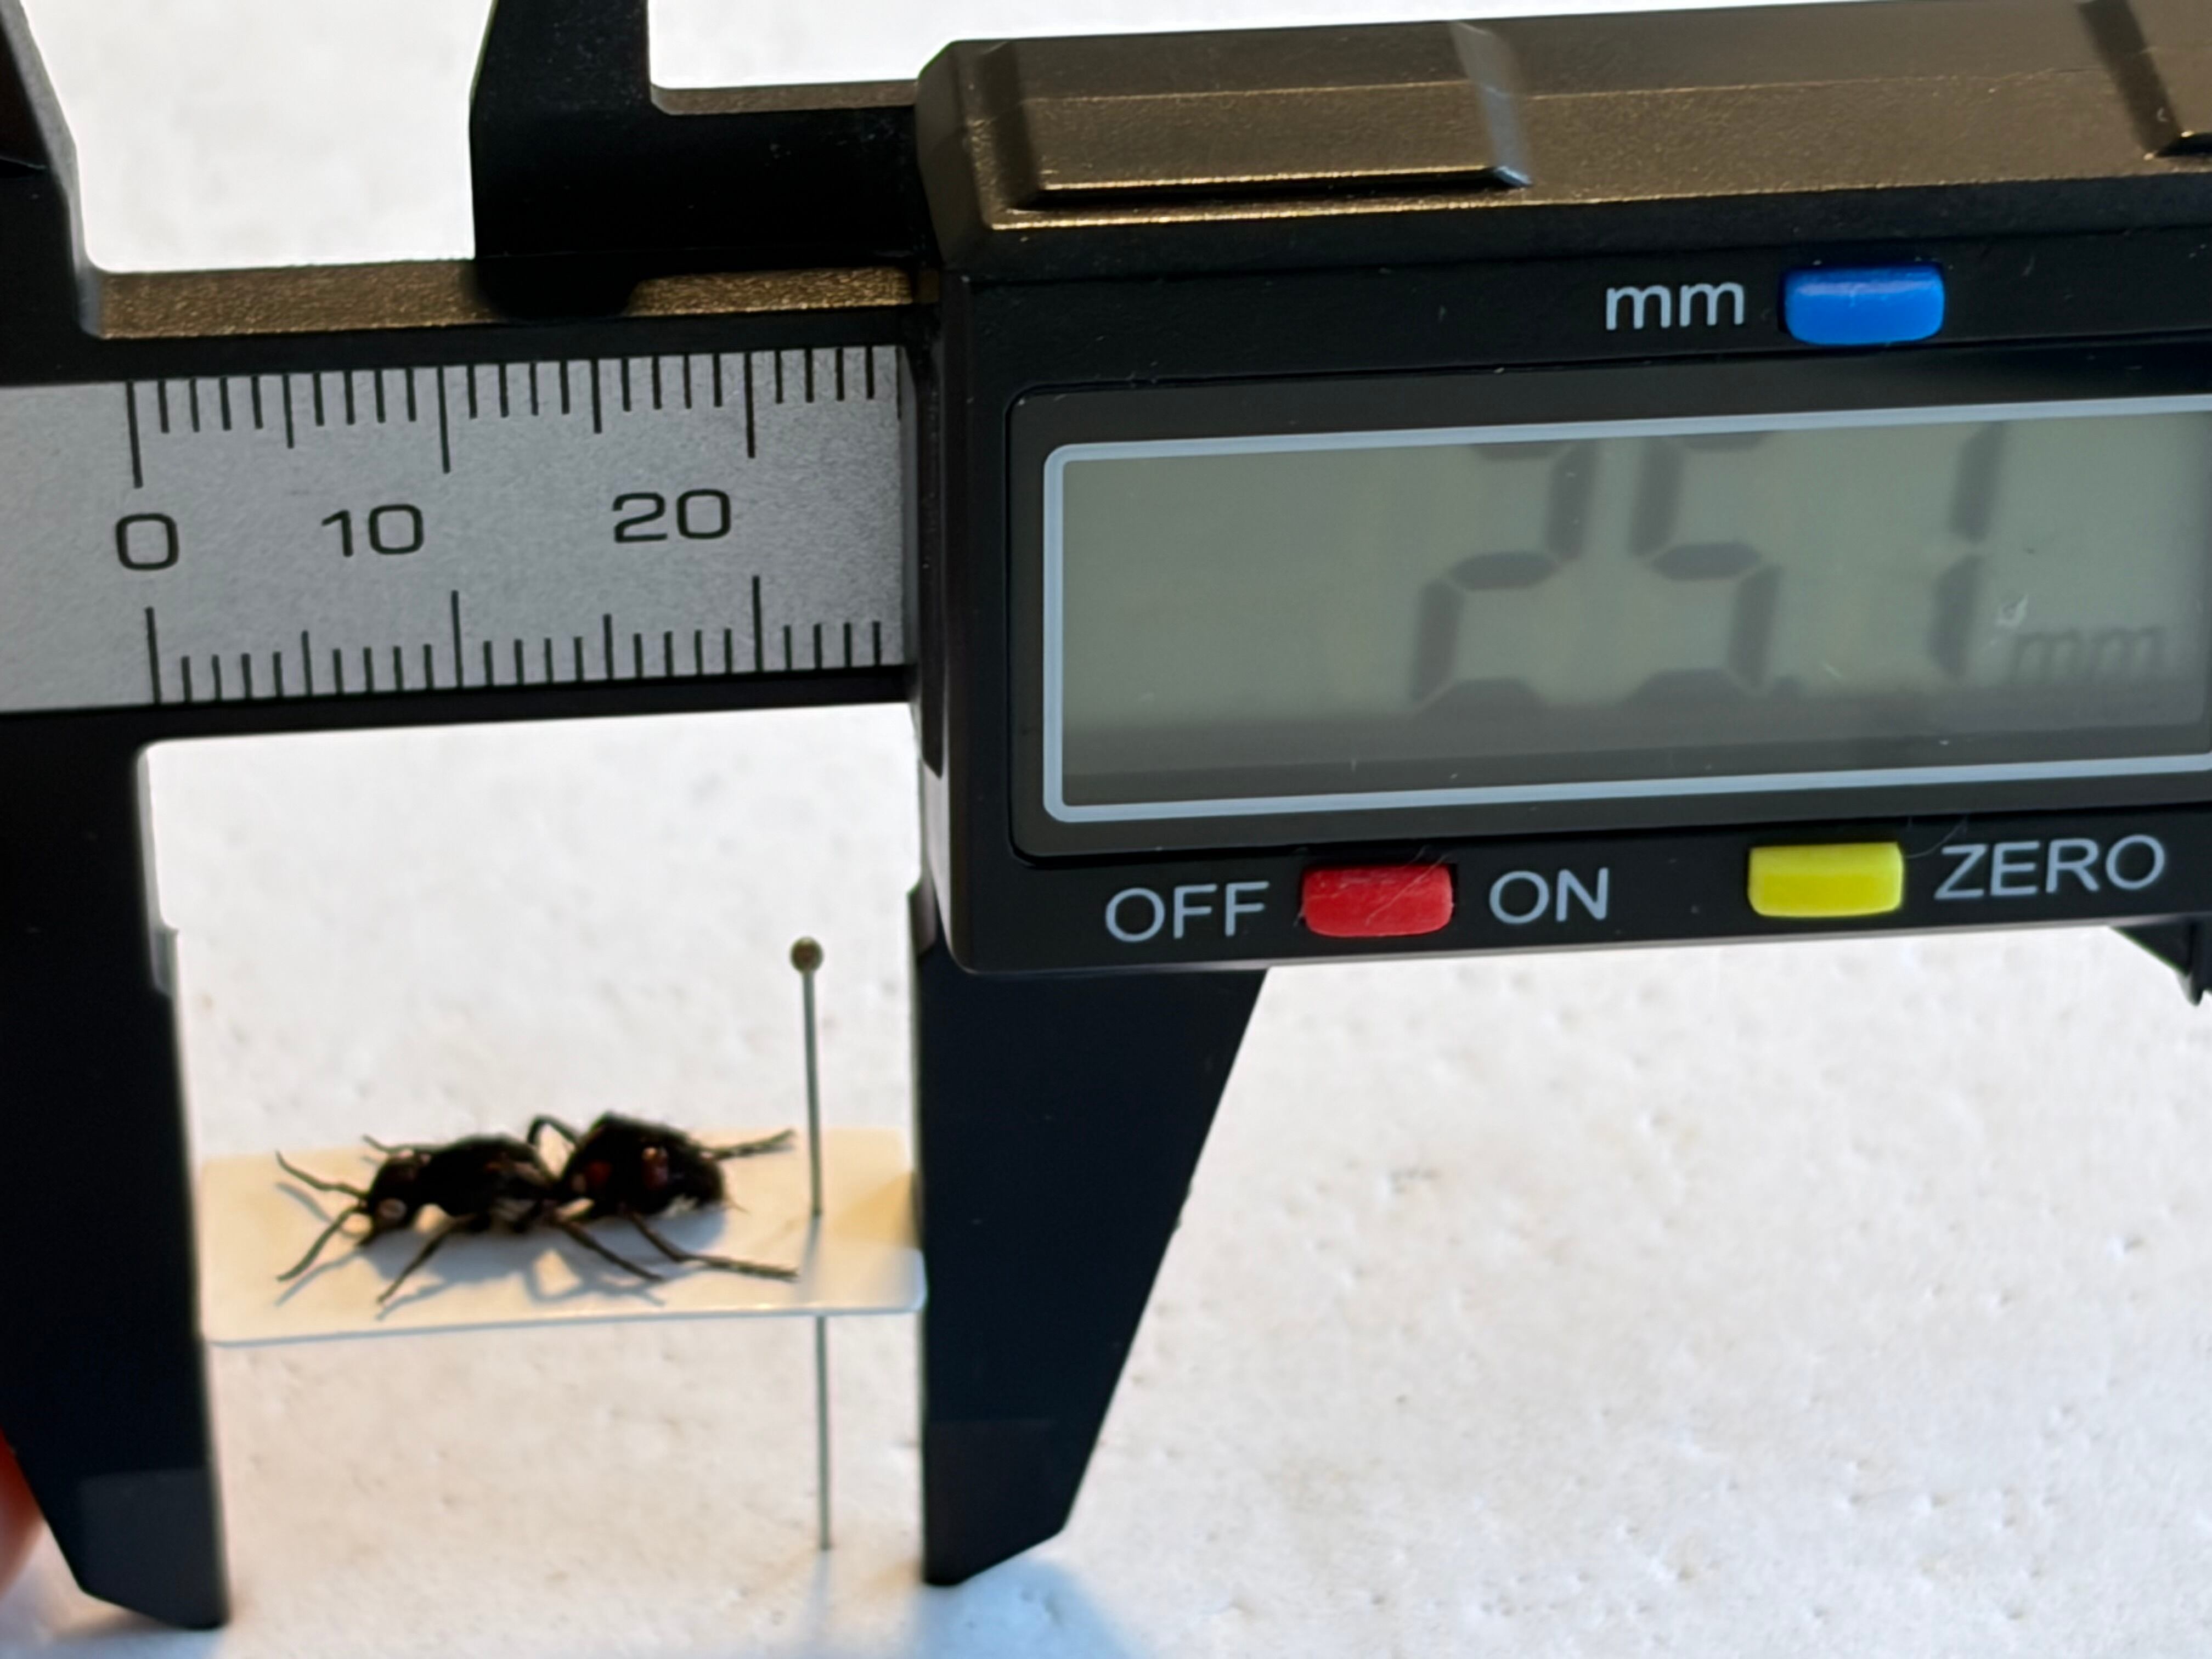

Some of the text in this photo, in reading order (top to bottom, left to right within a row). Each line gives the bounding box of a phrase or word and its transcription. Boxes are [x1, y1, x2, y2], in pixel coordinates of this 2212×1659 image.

[1605, 281, 1745, 330] mm
[114, 488, 732, 571] 0 10 20
[2010, 627, 2167, 685] mm
[1488, 866, 1611, 924] ON
[1933, 833, 2167, 901] ZERO
[1104, 880, 1269, 943] OFF
